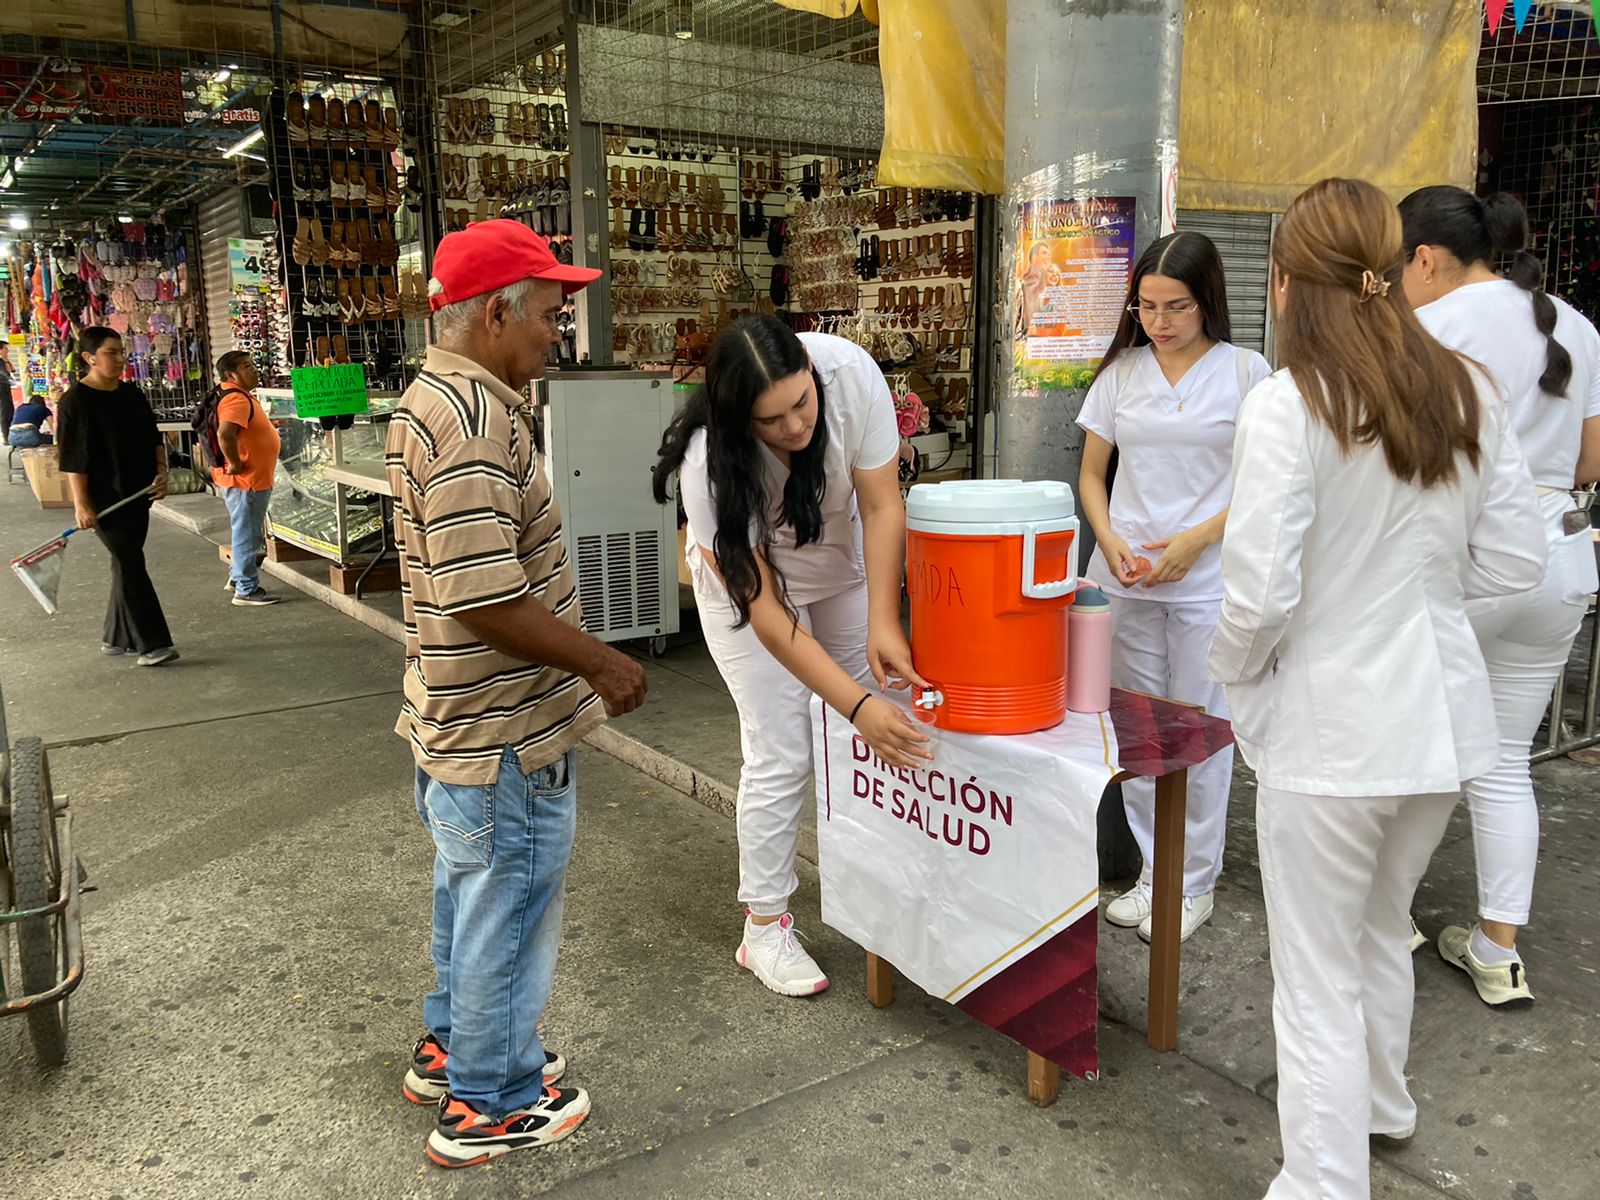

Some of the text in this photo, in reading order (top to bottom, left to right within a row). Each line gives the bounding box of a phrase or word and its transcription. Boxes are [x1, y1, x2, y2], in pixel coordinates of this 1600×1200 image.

[125, 76, 177, 88] PERNOS
[117, 87, 179, 100] CORREAS
[222, 108, 261, 124] gratis
[853, 769, 991, 856] DE SALUD
